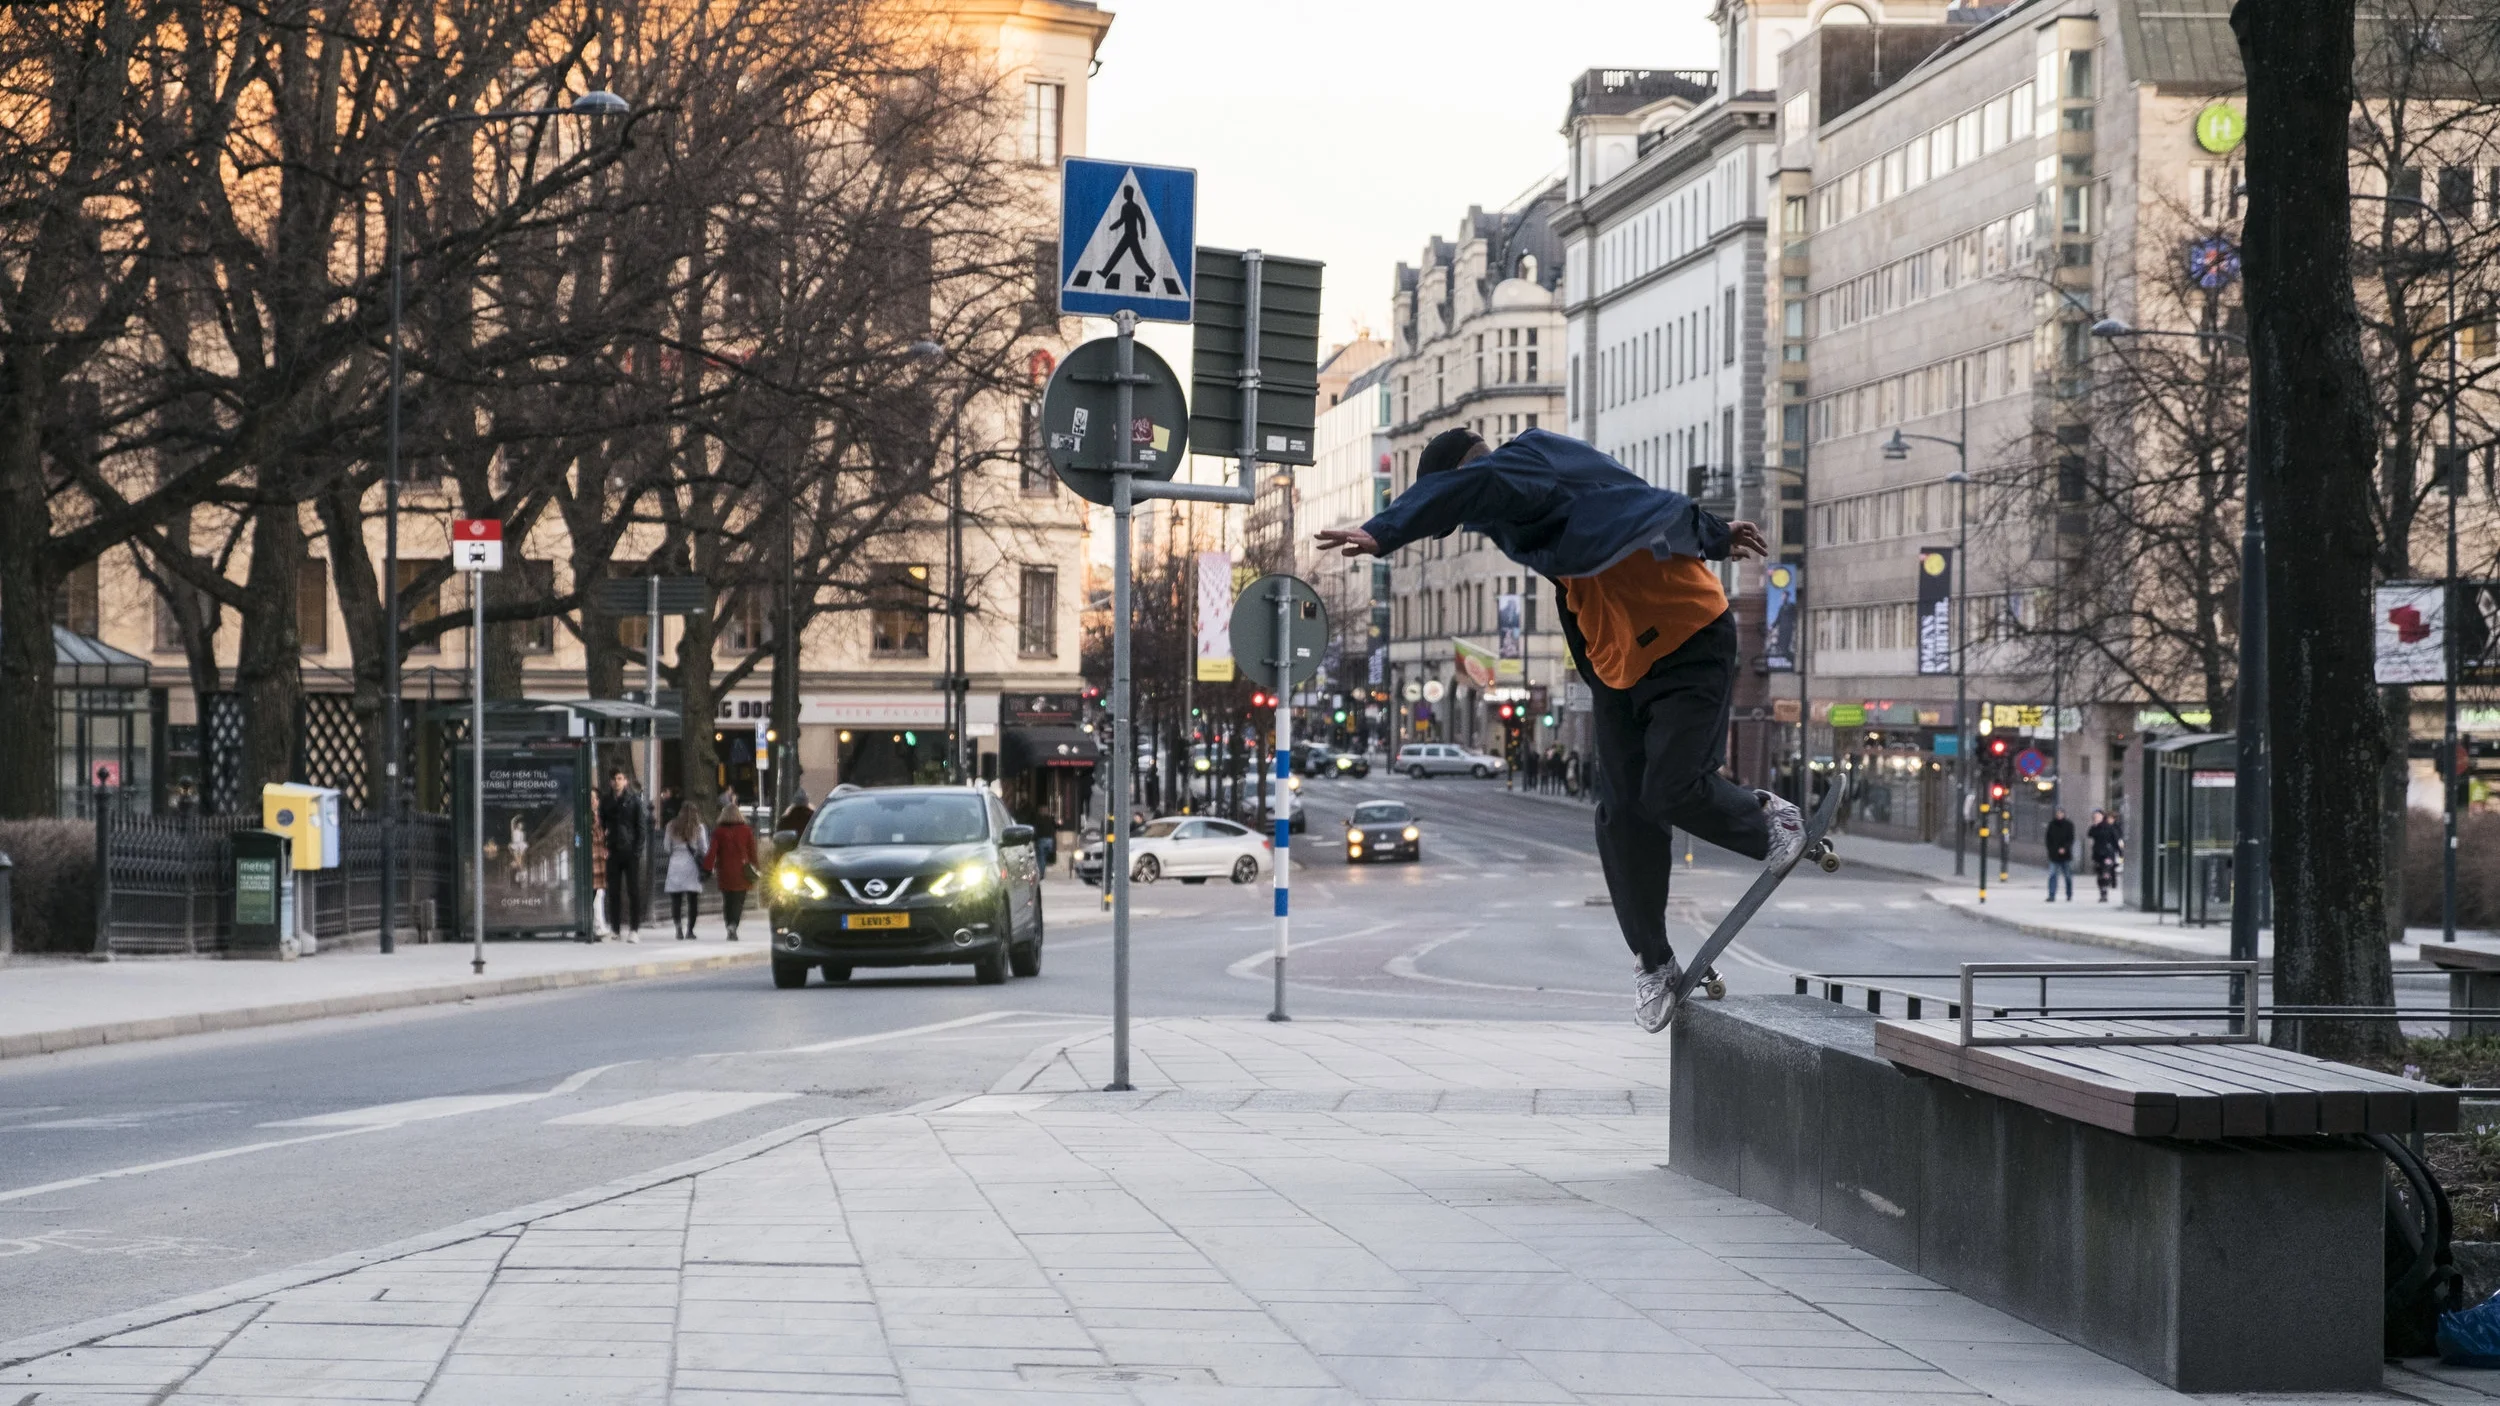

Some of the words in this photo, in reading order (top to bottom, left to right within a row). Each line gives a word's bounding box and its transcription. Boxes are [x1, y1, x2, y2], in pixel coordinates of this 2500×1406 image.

[2210, 115, 2232, 140] H
[489, 770, 511, 779] COM
[513, 780, 558, 789] BREDBAND
[861, 916, 892, 926] LEVI'S
